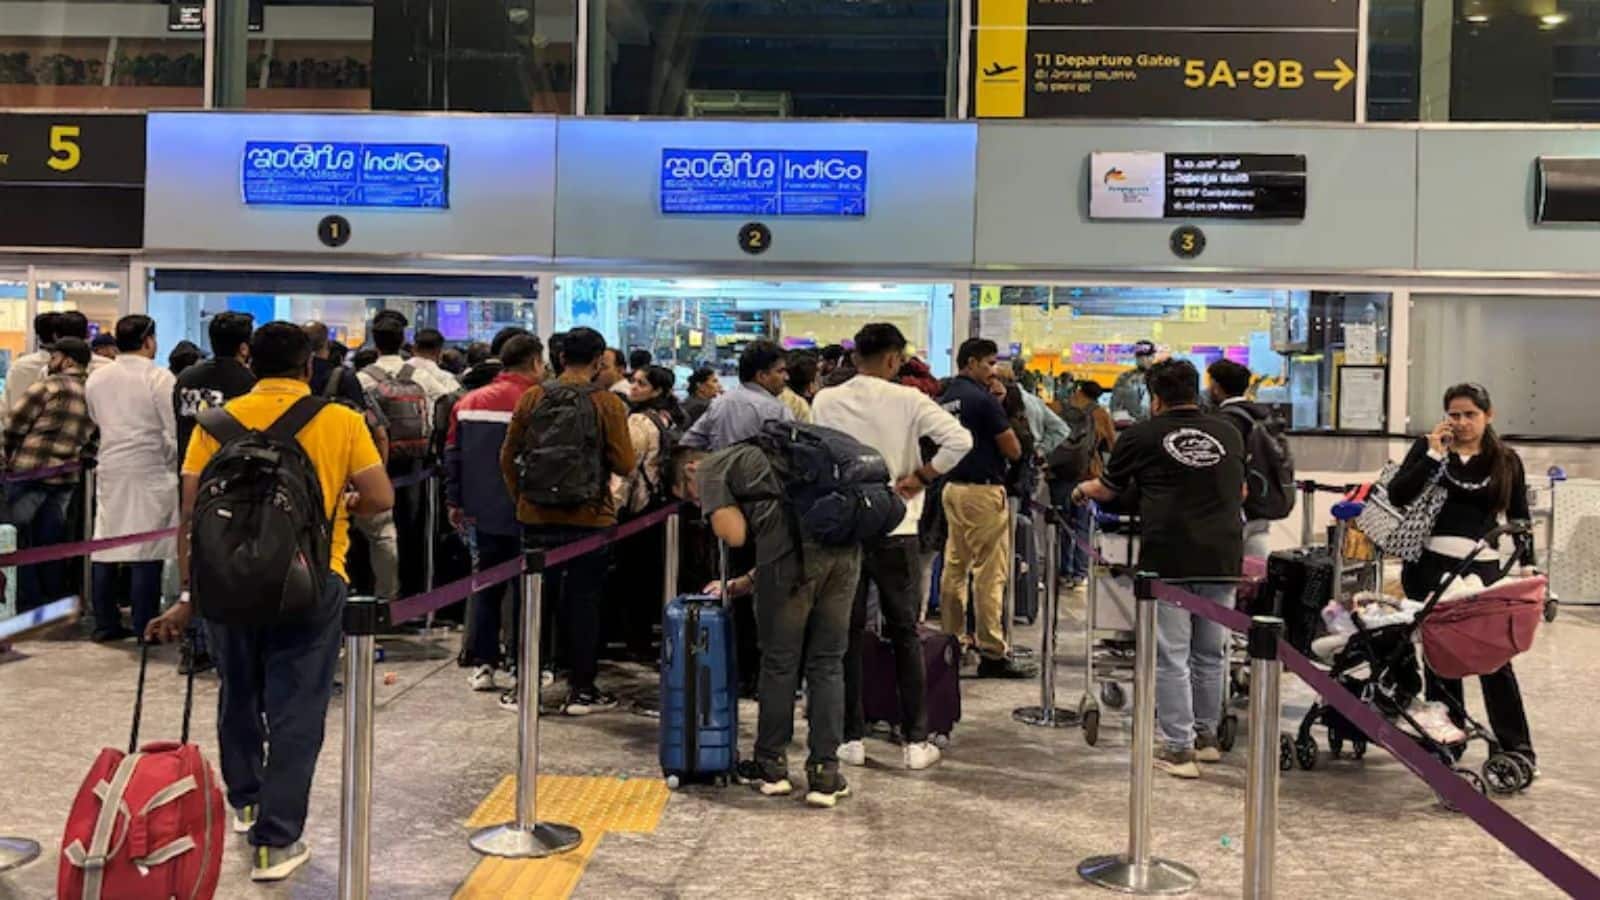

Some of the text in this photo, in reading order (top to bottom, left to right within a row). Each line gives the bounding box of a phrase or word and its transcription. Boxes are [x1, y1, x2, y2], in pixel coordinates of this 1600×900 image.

[1056, 54, 1133, 68] Departure
[1136, 54, 1181, 67] Gates
[1184, 59, 1304, 89] 5A-9B
[47, 125, 82, 171] 5
[363, 150, 441, 173] IndiGo
[784, 158, 863, 180] IndiGo
[329, 222, 340, 239] 1
[748, 230, 761, 247] 2
[1181, 233, 1195, 251] 3
